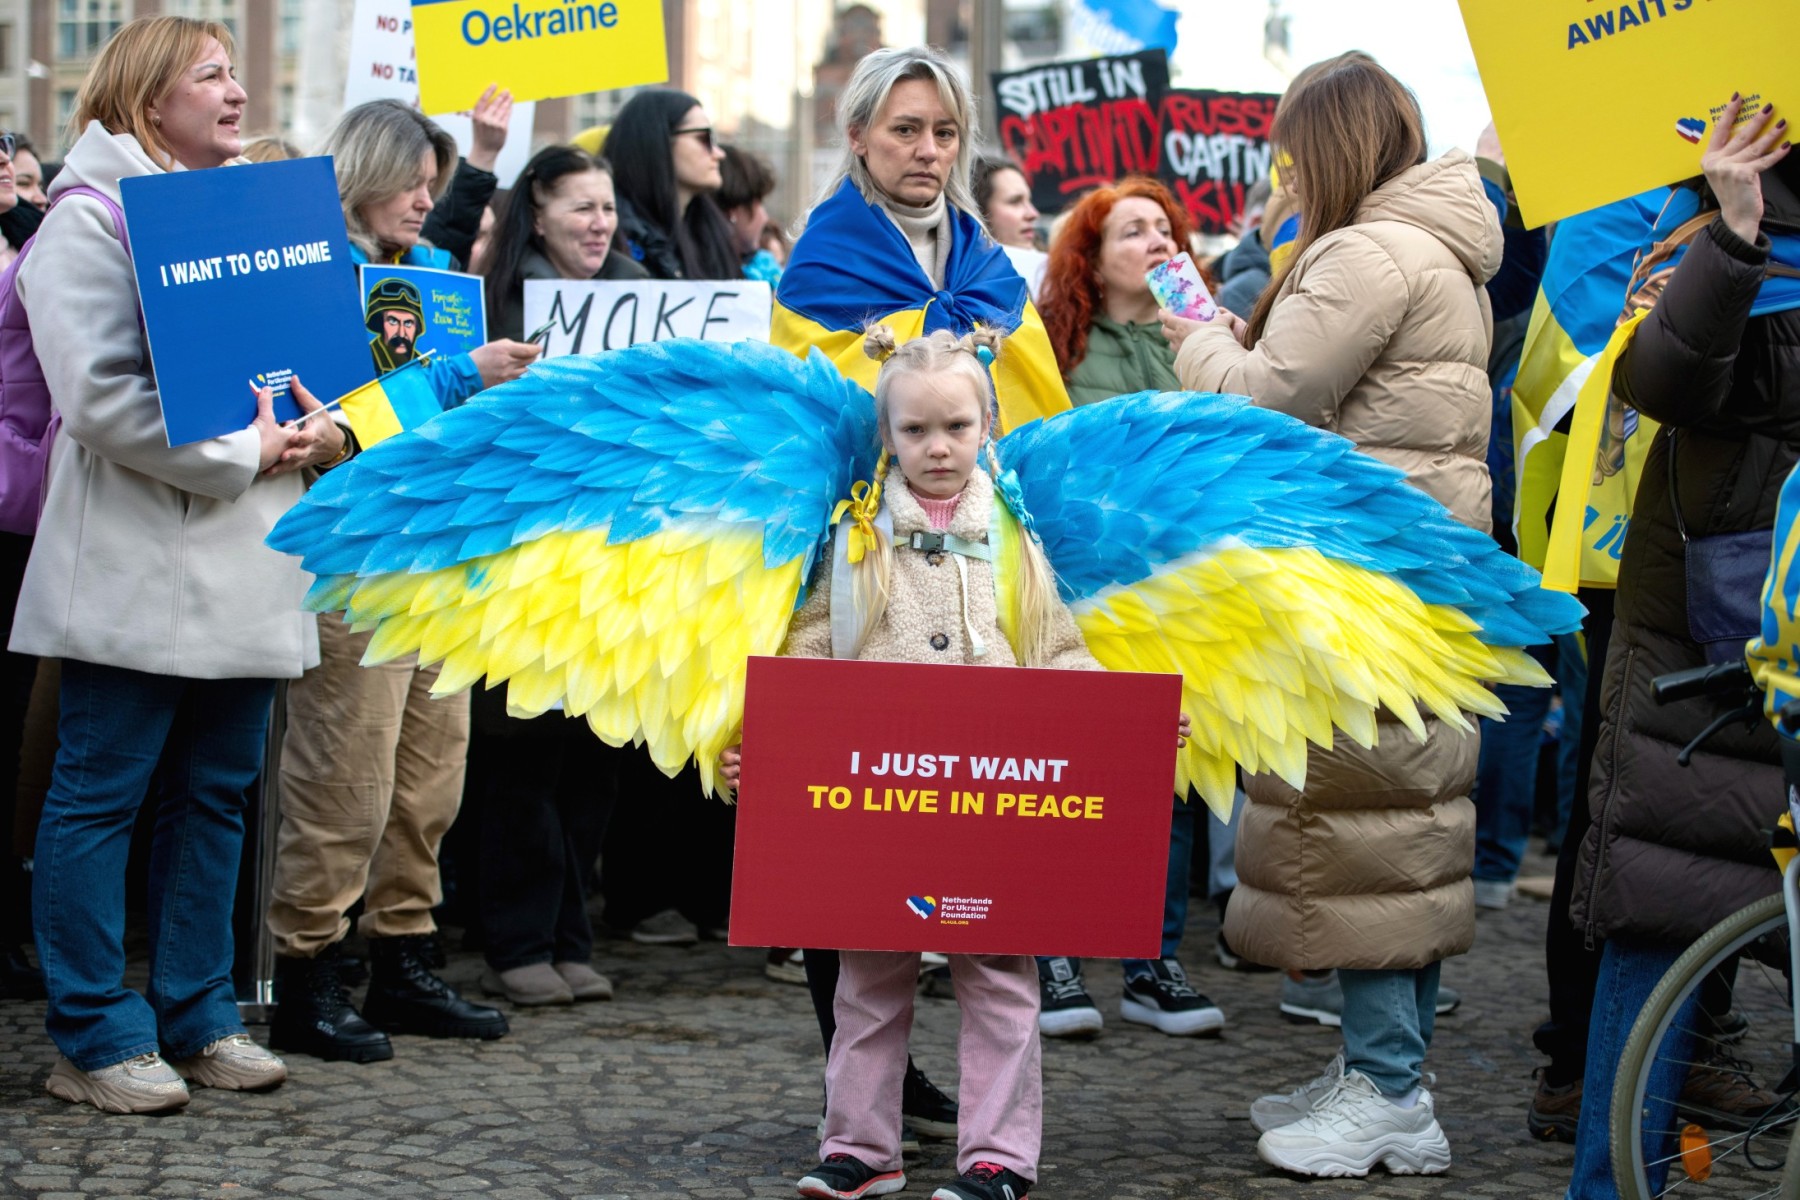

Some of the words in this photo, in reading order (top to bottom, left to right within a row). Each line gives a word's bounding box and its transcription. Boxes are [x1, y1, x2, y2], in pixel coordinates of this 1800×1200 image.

[376, 15, 399, 33] NO
[461, 0, 618, 46] Oekraïne
[371, 63, 393, 81] NO
[160, 265, 169, 287] I
[171, 257, 222, 285] WANT
[226, 253, 251, 276] TO
[255, 249, 280, 272] GO
[282, 241, 332, 268] HOME
[850, 751, 860, 775] I
[871, 753, 960, 779] JUST
[970, 756, 1069, 783] WANT
[807, 785, 852, 810] TO
[863, 787, 939, 814] LIVE
[950, 791, 984, 815] IN
[996, 793, 1104, 820] PEACE
[941, 904, 955, 912] For
[956, 905, 989, 913] Ukraine
[942, 896, 993, 905] Netherlands
[941, 911, 987, 920] Foundation
